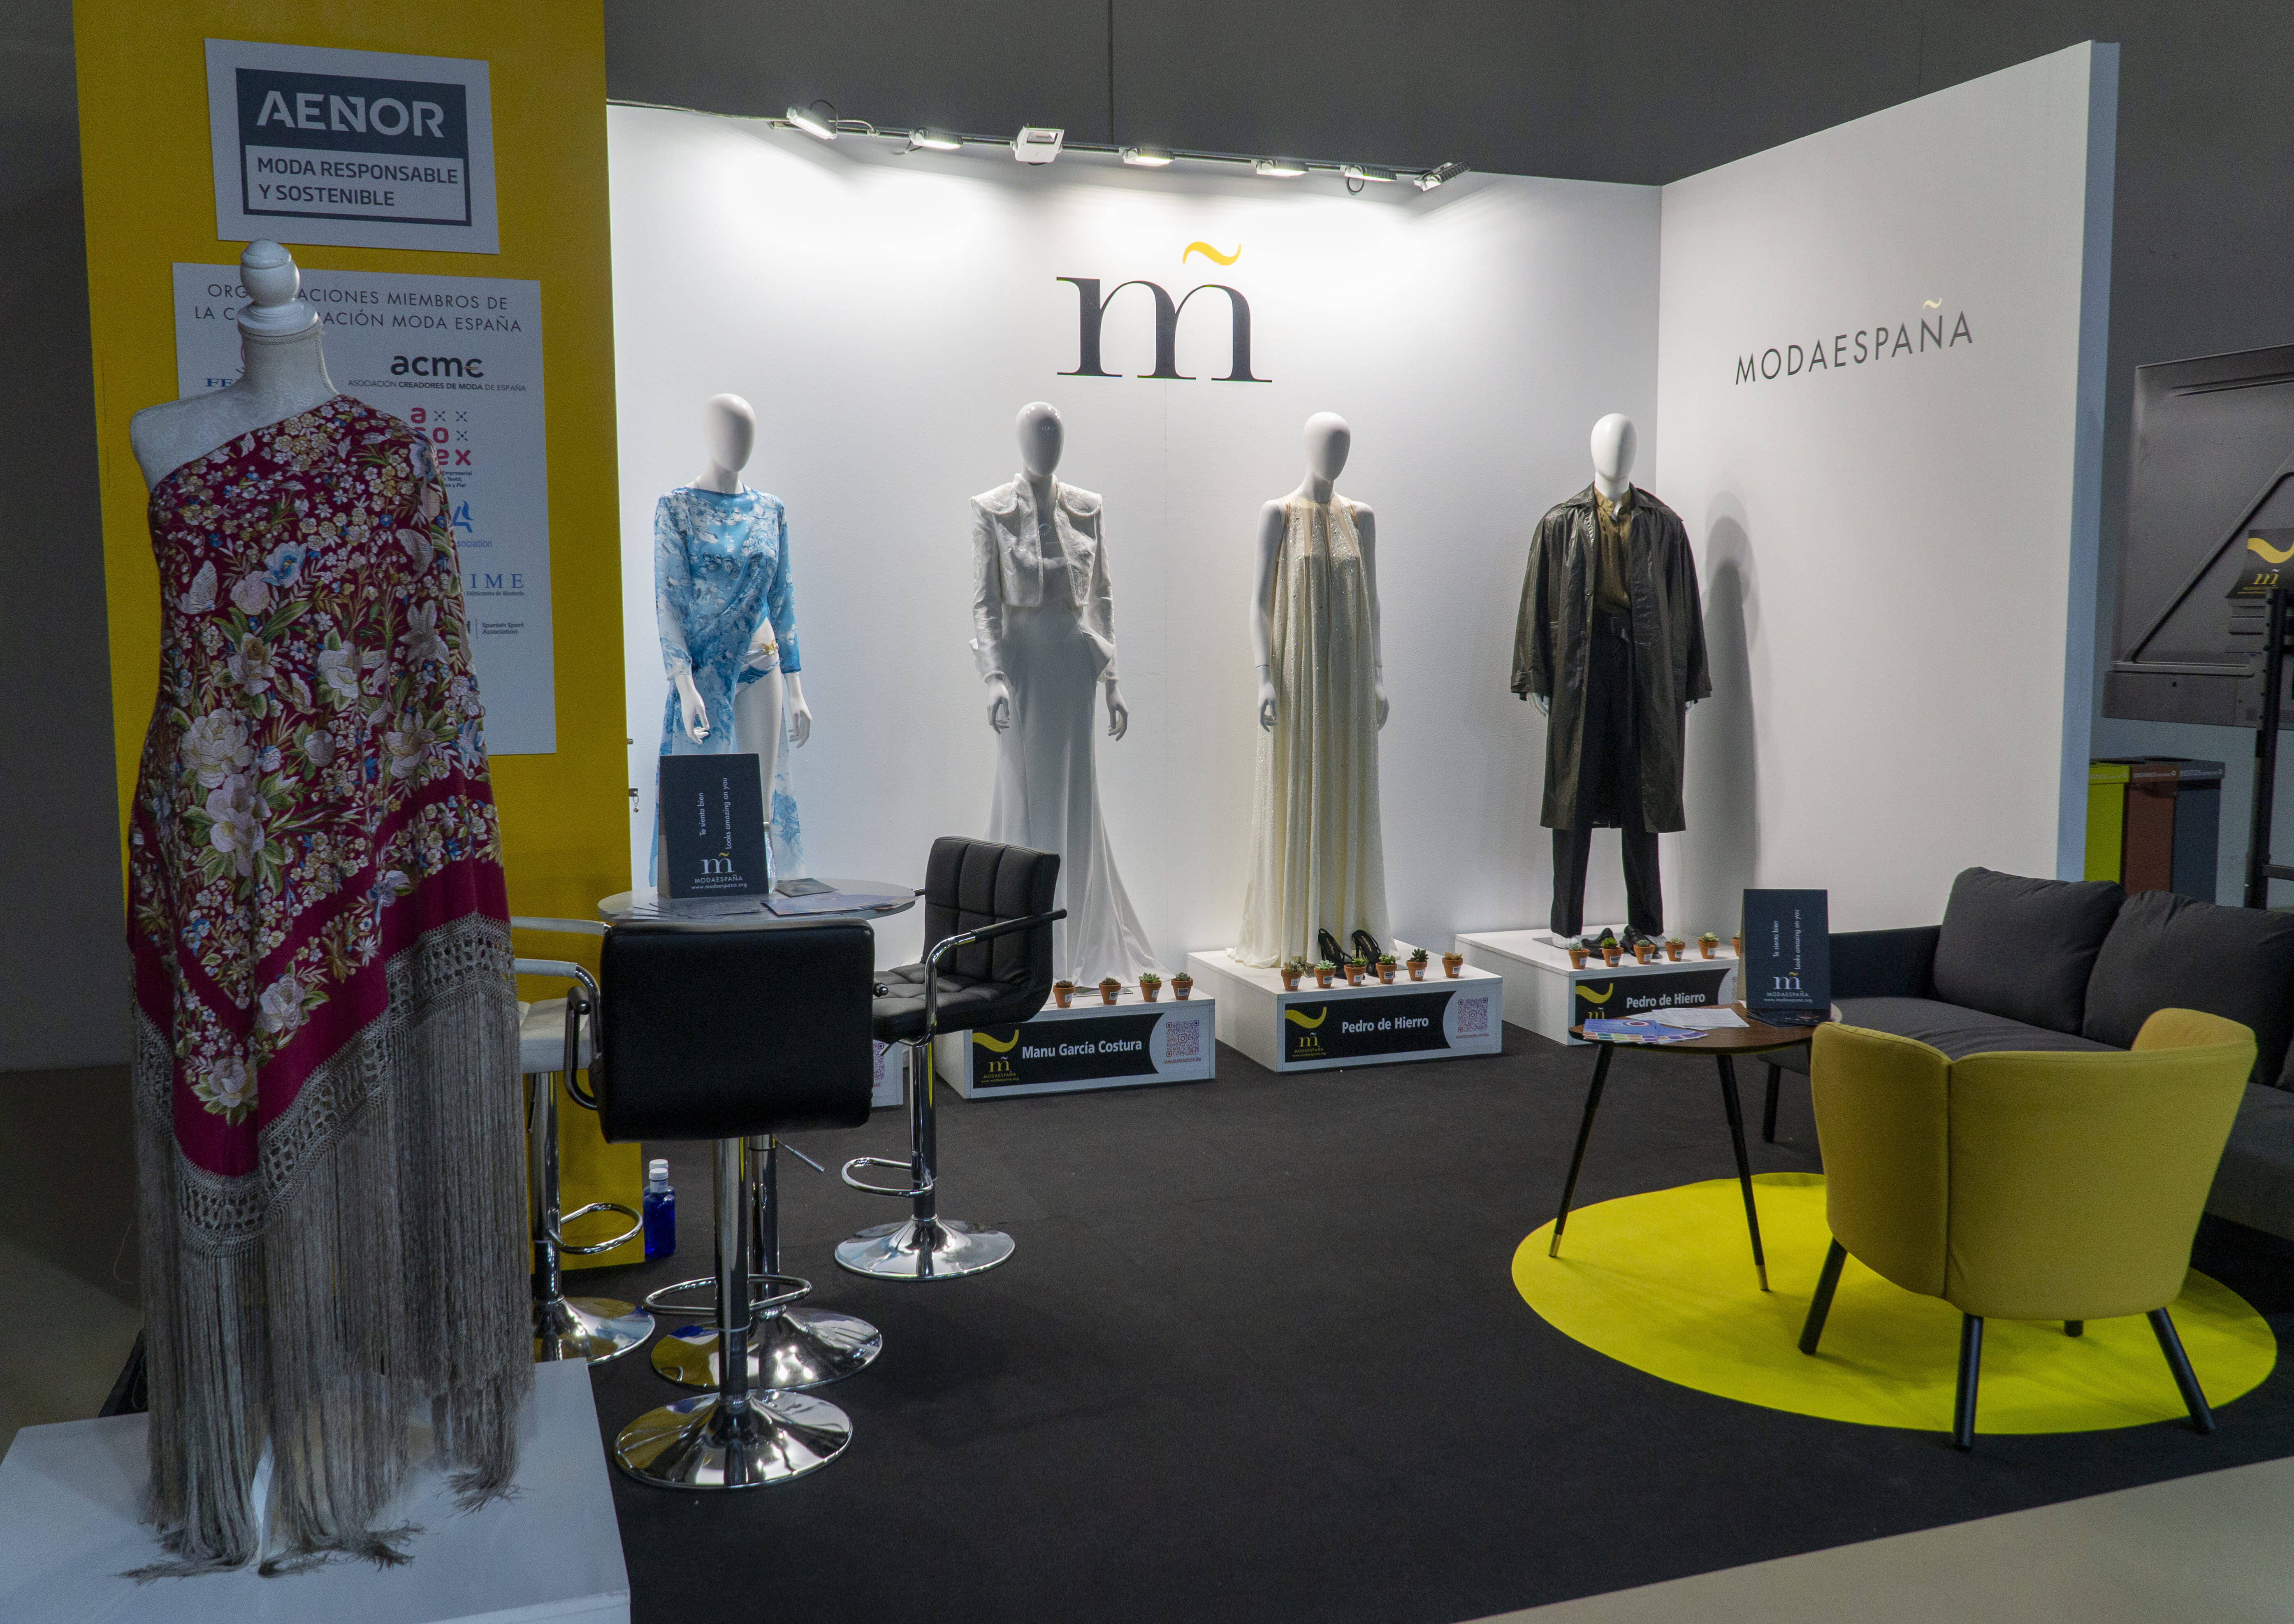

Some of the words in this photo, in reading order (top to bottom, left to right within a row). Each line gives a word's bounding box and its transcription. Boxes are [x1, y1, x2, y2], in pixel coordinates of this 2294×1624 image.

[257, 90, 444, 138] AENOR
[257, 157, 315, 176] MODA
[321, 161, 458, 183] RESPONSABLE
[258, 184, 272, 199] Y
[276, 185, 394, 206] SOSTENIBLE
[208, 284, 378, 304] ORGACIONES
[387, 292, 480, 309] MIEMBROS
[488, 297, 508, 310] DE
[195, 306, 215, 319] LA
[392, 316, 447, 329] MODA
[455, 315, 522, 332] ESPAÑA
[1735, 297, 1973, 385] MODAESPAÑA
[390, 355, 485, 378] acme
[348, 379, 396, 387] ASOCIACIÓN
[436, 449, 471, 466] ex
[724, 791, 728, 800] on
[700, 827, 706, 836] Te
[724, 831, 732, 849] Looks
[694, 874, 743, 884] MODAESPAÑA
[1626, 995, 1657, 1009] Pedro
[1659, 993, 1672, 1005] de
[1674, 993, 1706, 1005] Hierro
[1342, 1019, 1374, 1033] Pedro
[1378, 1017, 1391, 1030] de
[1394, 1016, 1429, 1029] Hierro
[1022, 1045, 1055, 1060] Manu
[1059, 1040, 1095, 1056] García
[1098, 1039, 1142, 1053] Costura
